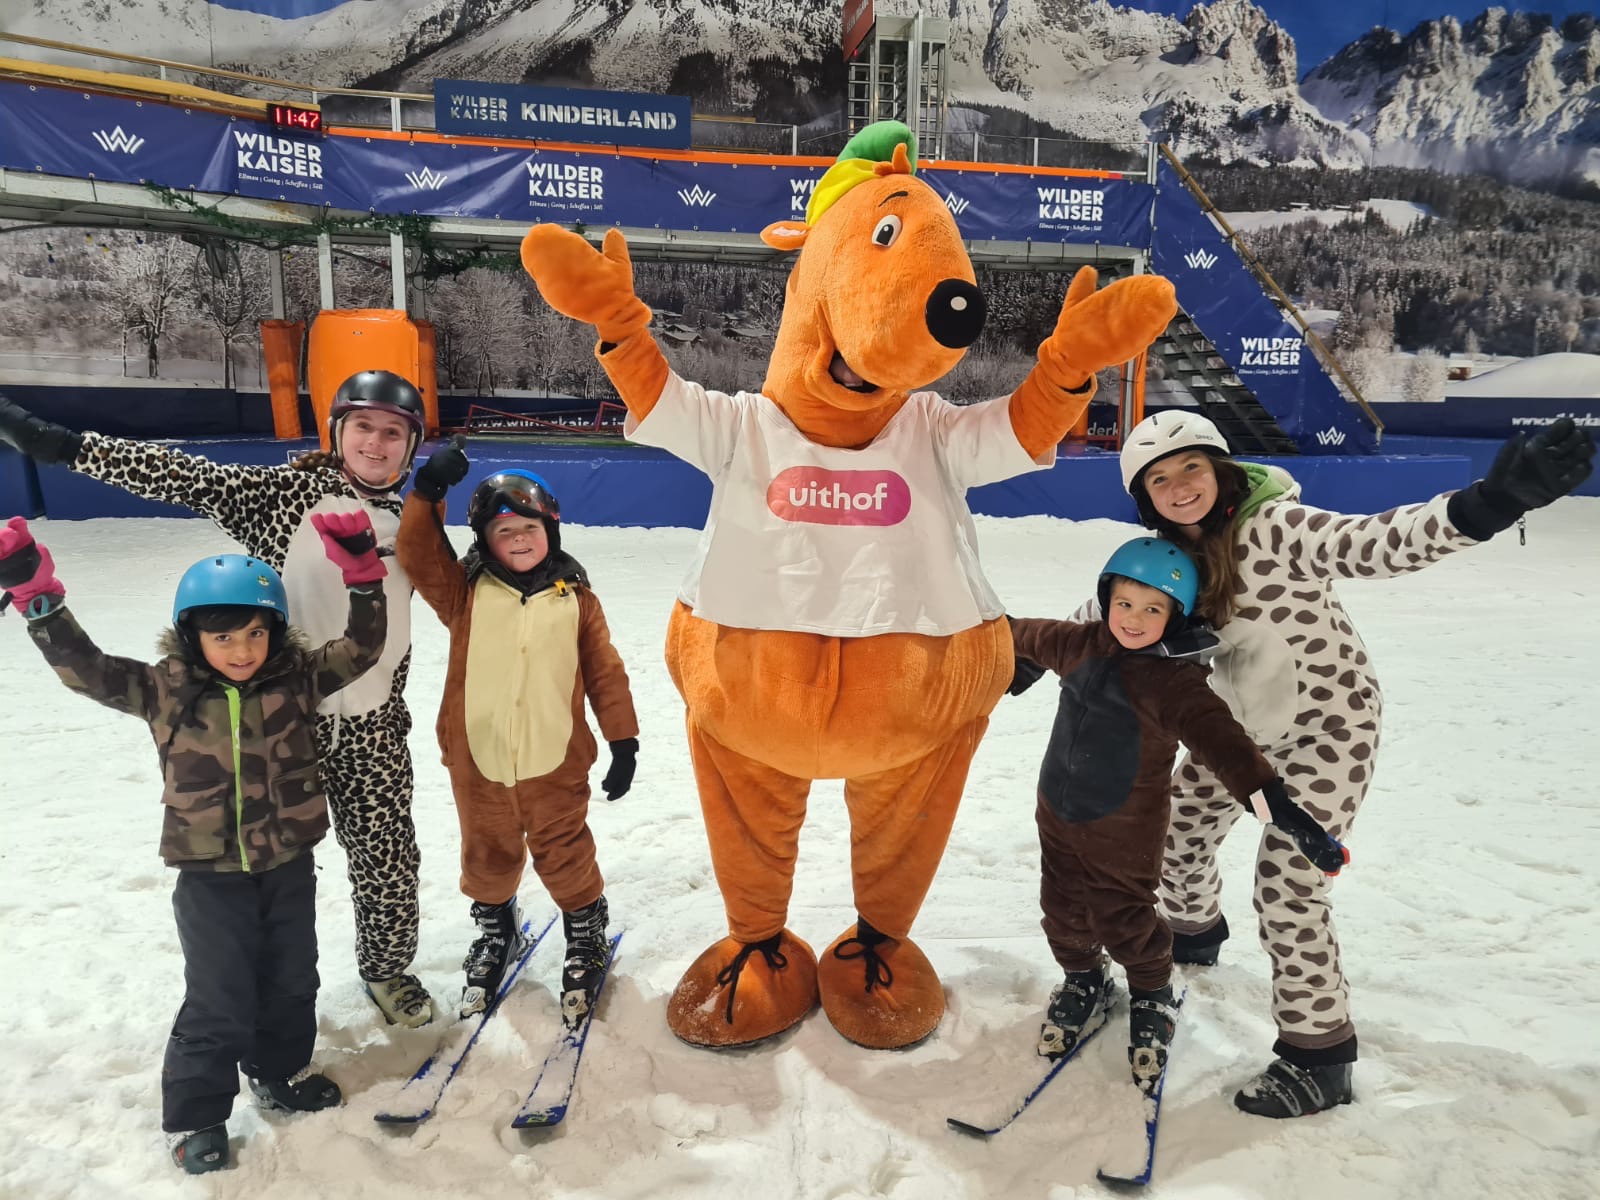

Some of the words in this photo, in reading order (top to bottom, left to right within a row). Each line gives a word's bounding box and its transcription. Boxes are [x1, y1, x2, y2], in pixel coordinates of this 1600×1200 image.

[451, 94, 508, 110] WILDER
[275, 107, 320, 128] 11:47
[451, 107, 508, 122] KAISER
[521, 102, 677, 130] KINDERLAND
[233, 130, 322, 162] WILDER
[237, 150, 323, 179] KAISER
[526, 162, 603, 183] WILDER
[529, 180, 603, 200] KAISER
[1037, 187, 1104, 205] WILDER
[1040, 204, 1103, 221] KAISER
[1241, 337, 1302, 351] WILDER
[1240, 352, 1300, 365] KAISER
[789, 480, 888, 511] uithof
